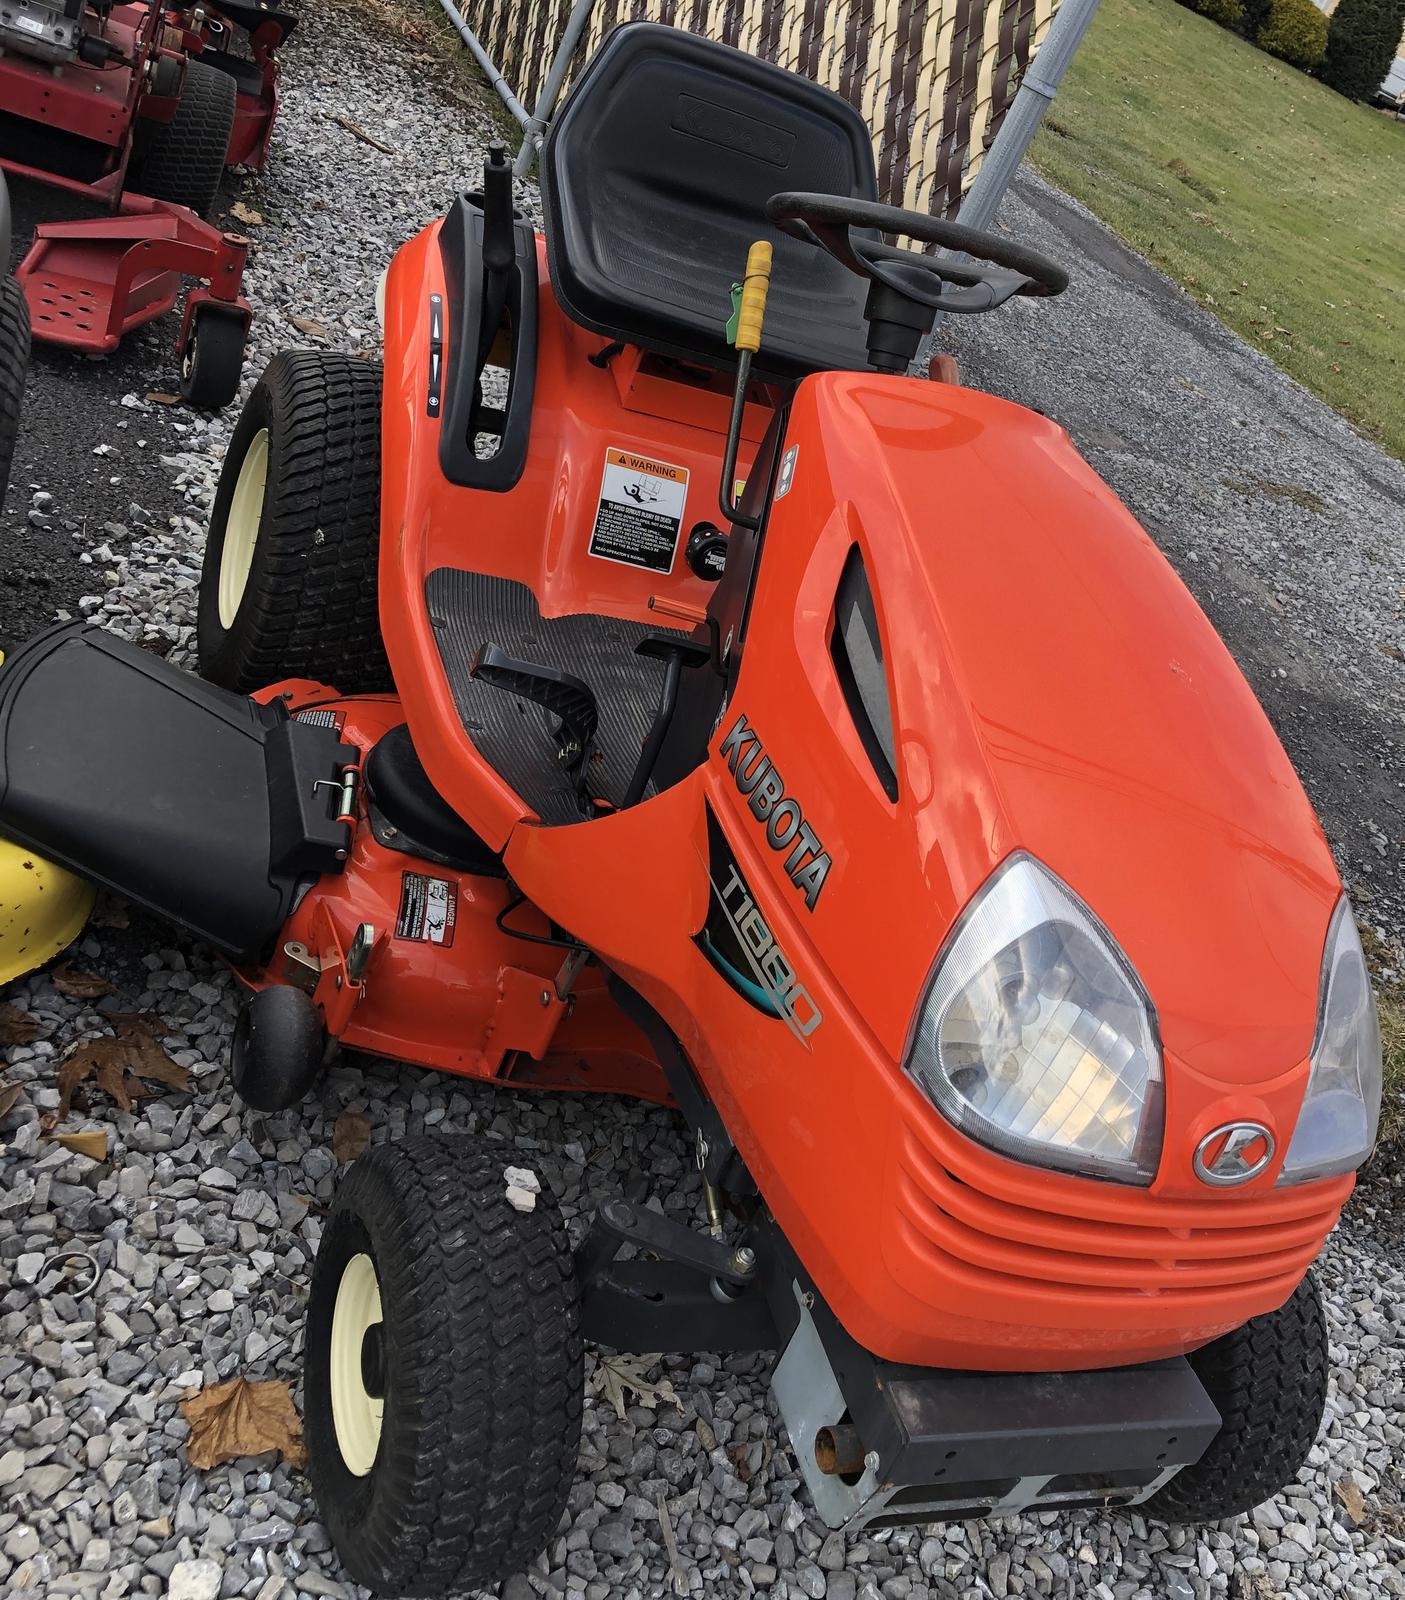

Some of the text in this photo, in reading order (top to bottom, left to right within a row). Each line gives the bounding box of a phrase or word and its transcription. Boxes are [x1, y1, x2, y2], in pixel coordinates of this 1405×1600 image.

[630, 459, 676, 478] WARNING
[719, 714, 833, 913] KUBOTA
[447, 900, 456, 926] DANGER
[721, 864, 823, 1036] T1880
